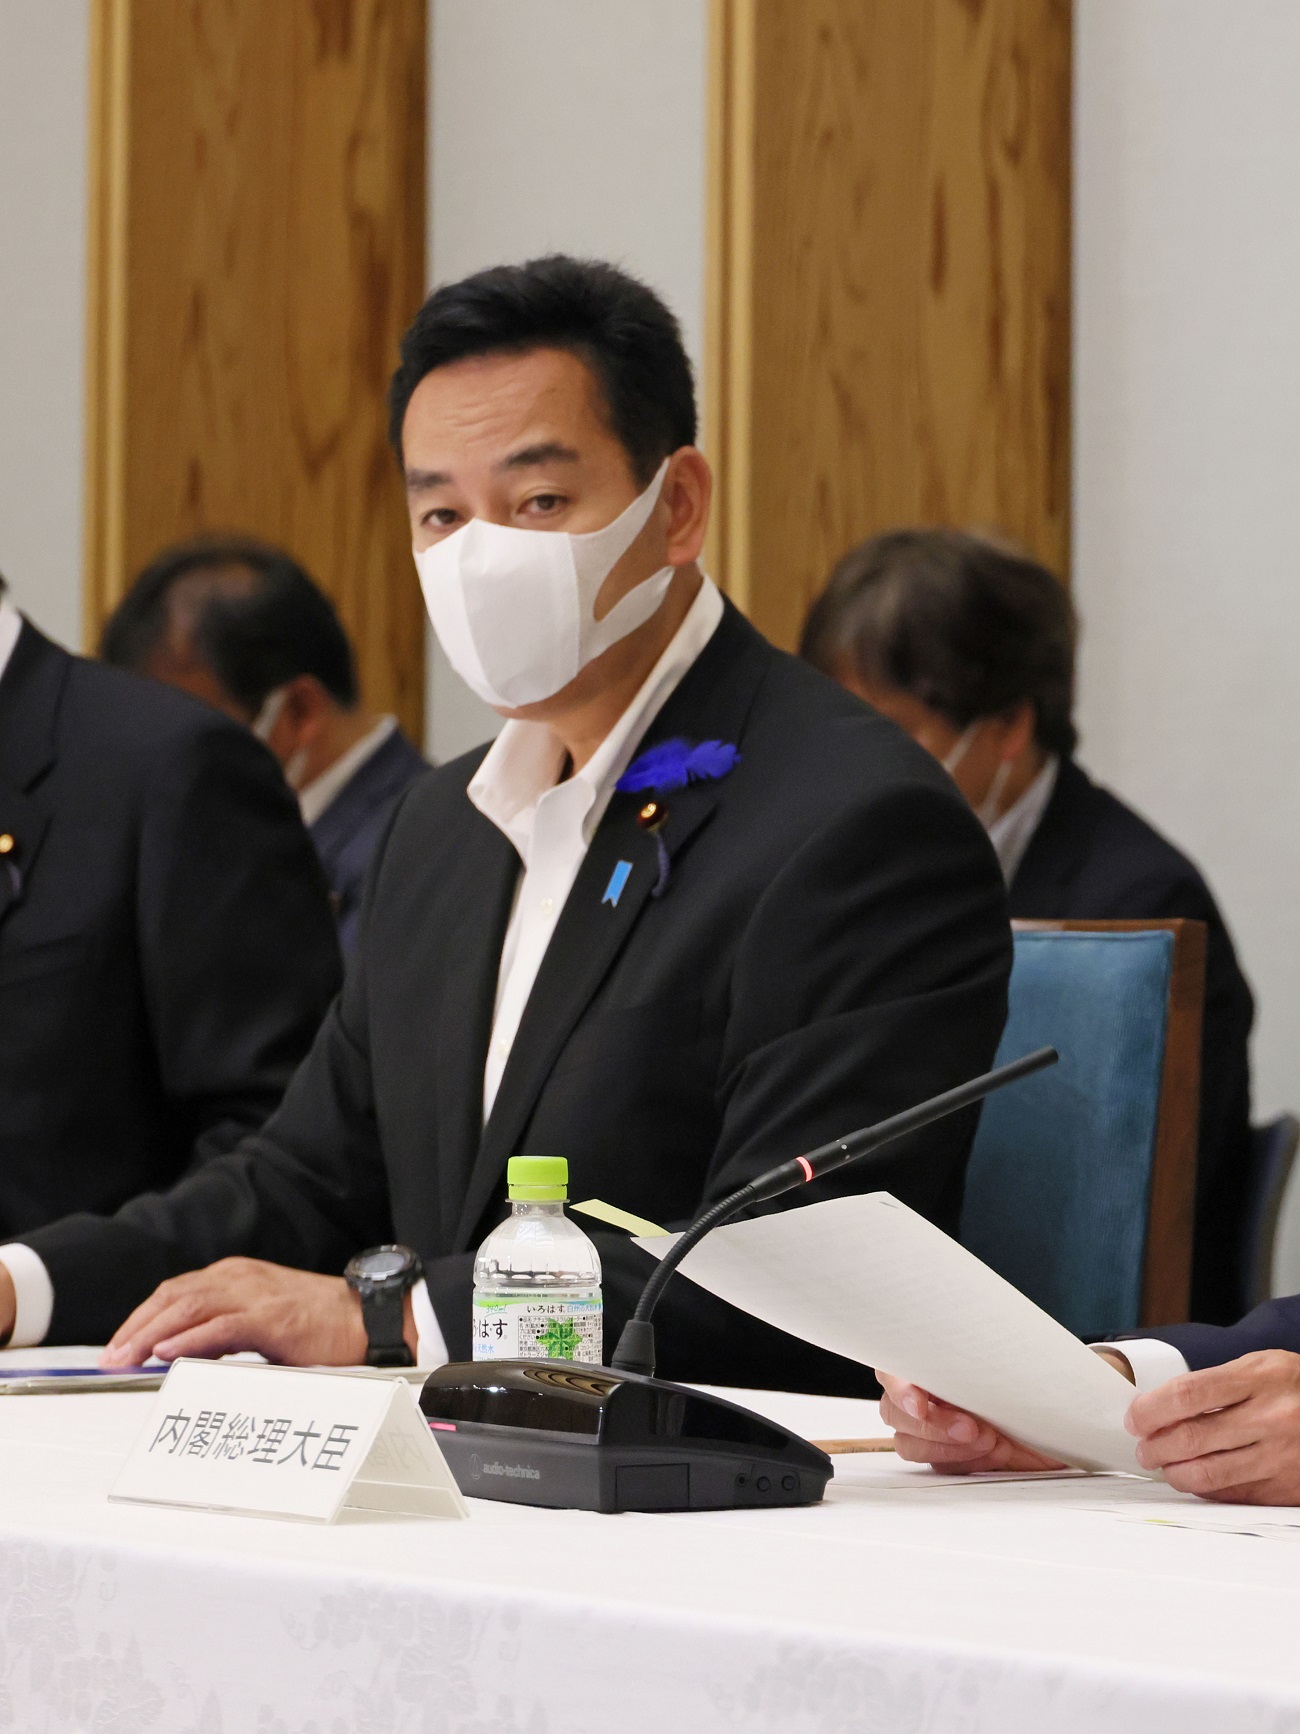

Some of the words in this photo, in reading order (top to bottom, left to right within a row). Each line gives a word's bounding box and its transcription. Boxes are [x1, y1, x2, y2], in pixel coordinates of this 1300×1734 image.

[527, 1304, 564, 1313] いろはす
[149, 1408, 359, 1471] 内閣総理大臣
[483, 1461, 540, 1480] audio-technica
